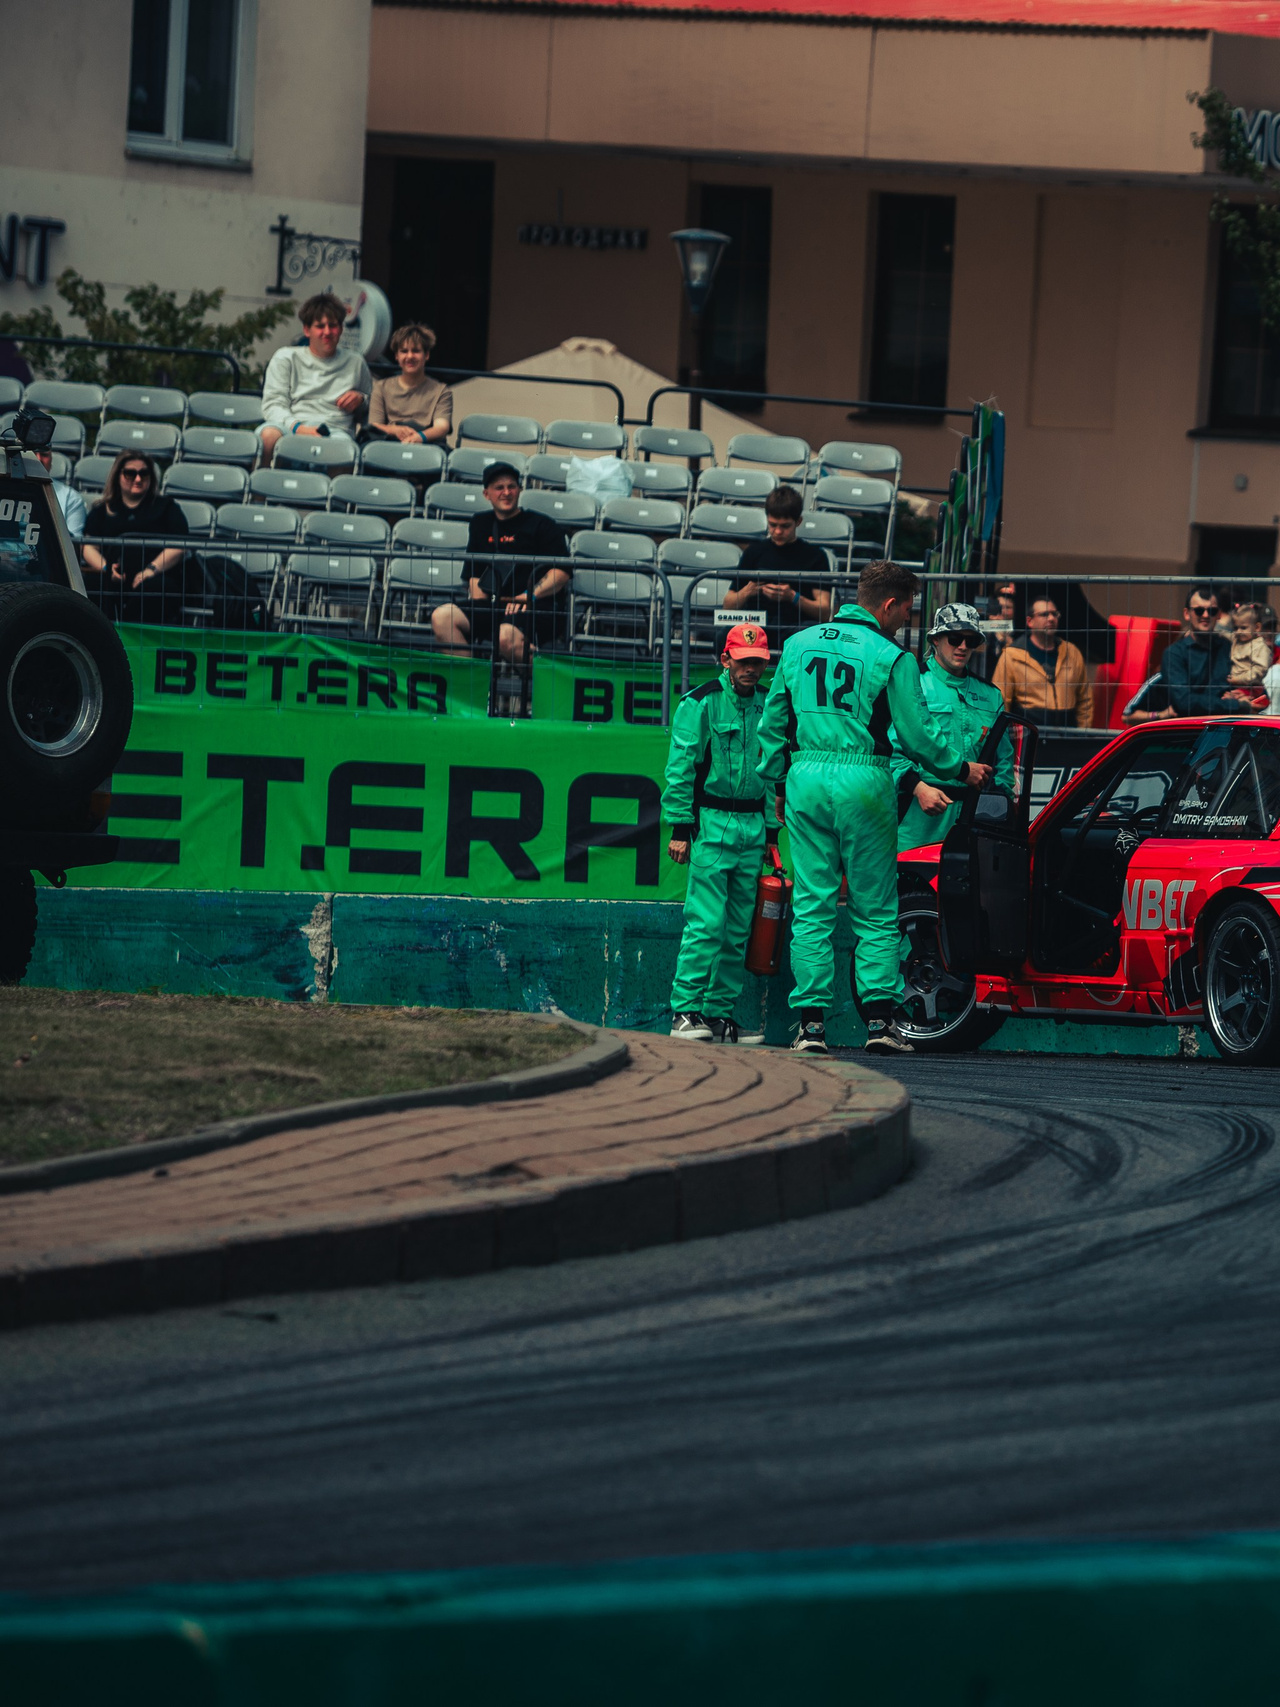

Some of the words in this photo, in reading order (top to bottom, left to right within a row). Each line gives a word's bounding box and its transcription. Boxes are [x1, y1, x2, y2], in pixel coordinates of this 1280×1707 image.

[744, 614, 761, 622] LINE
[804, 656, 856, 713] 12
[1172, 813, 1204, 825] DMITRY
[1203, 815, 1249, 826] SAMOSHKIN
